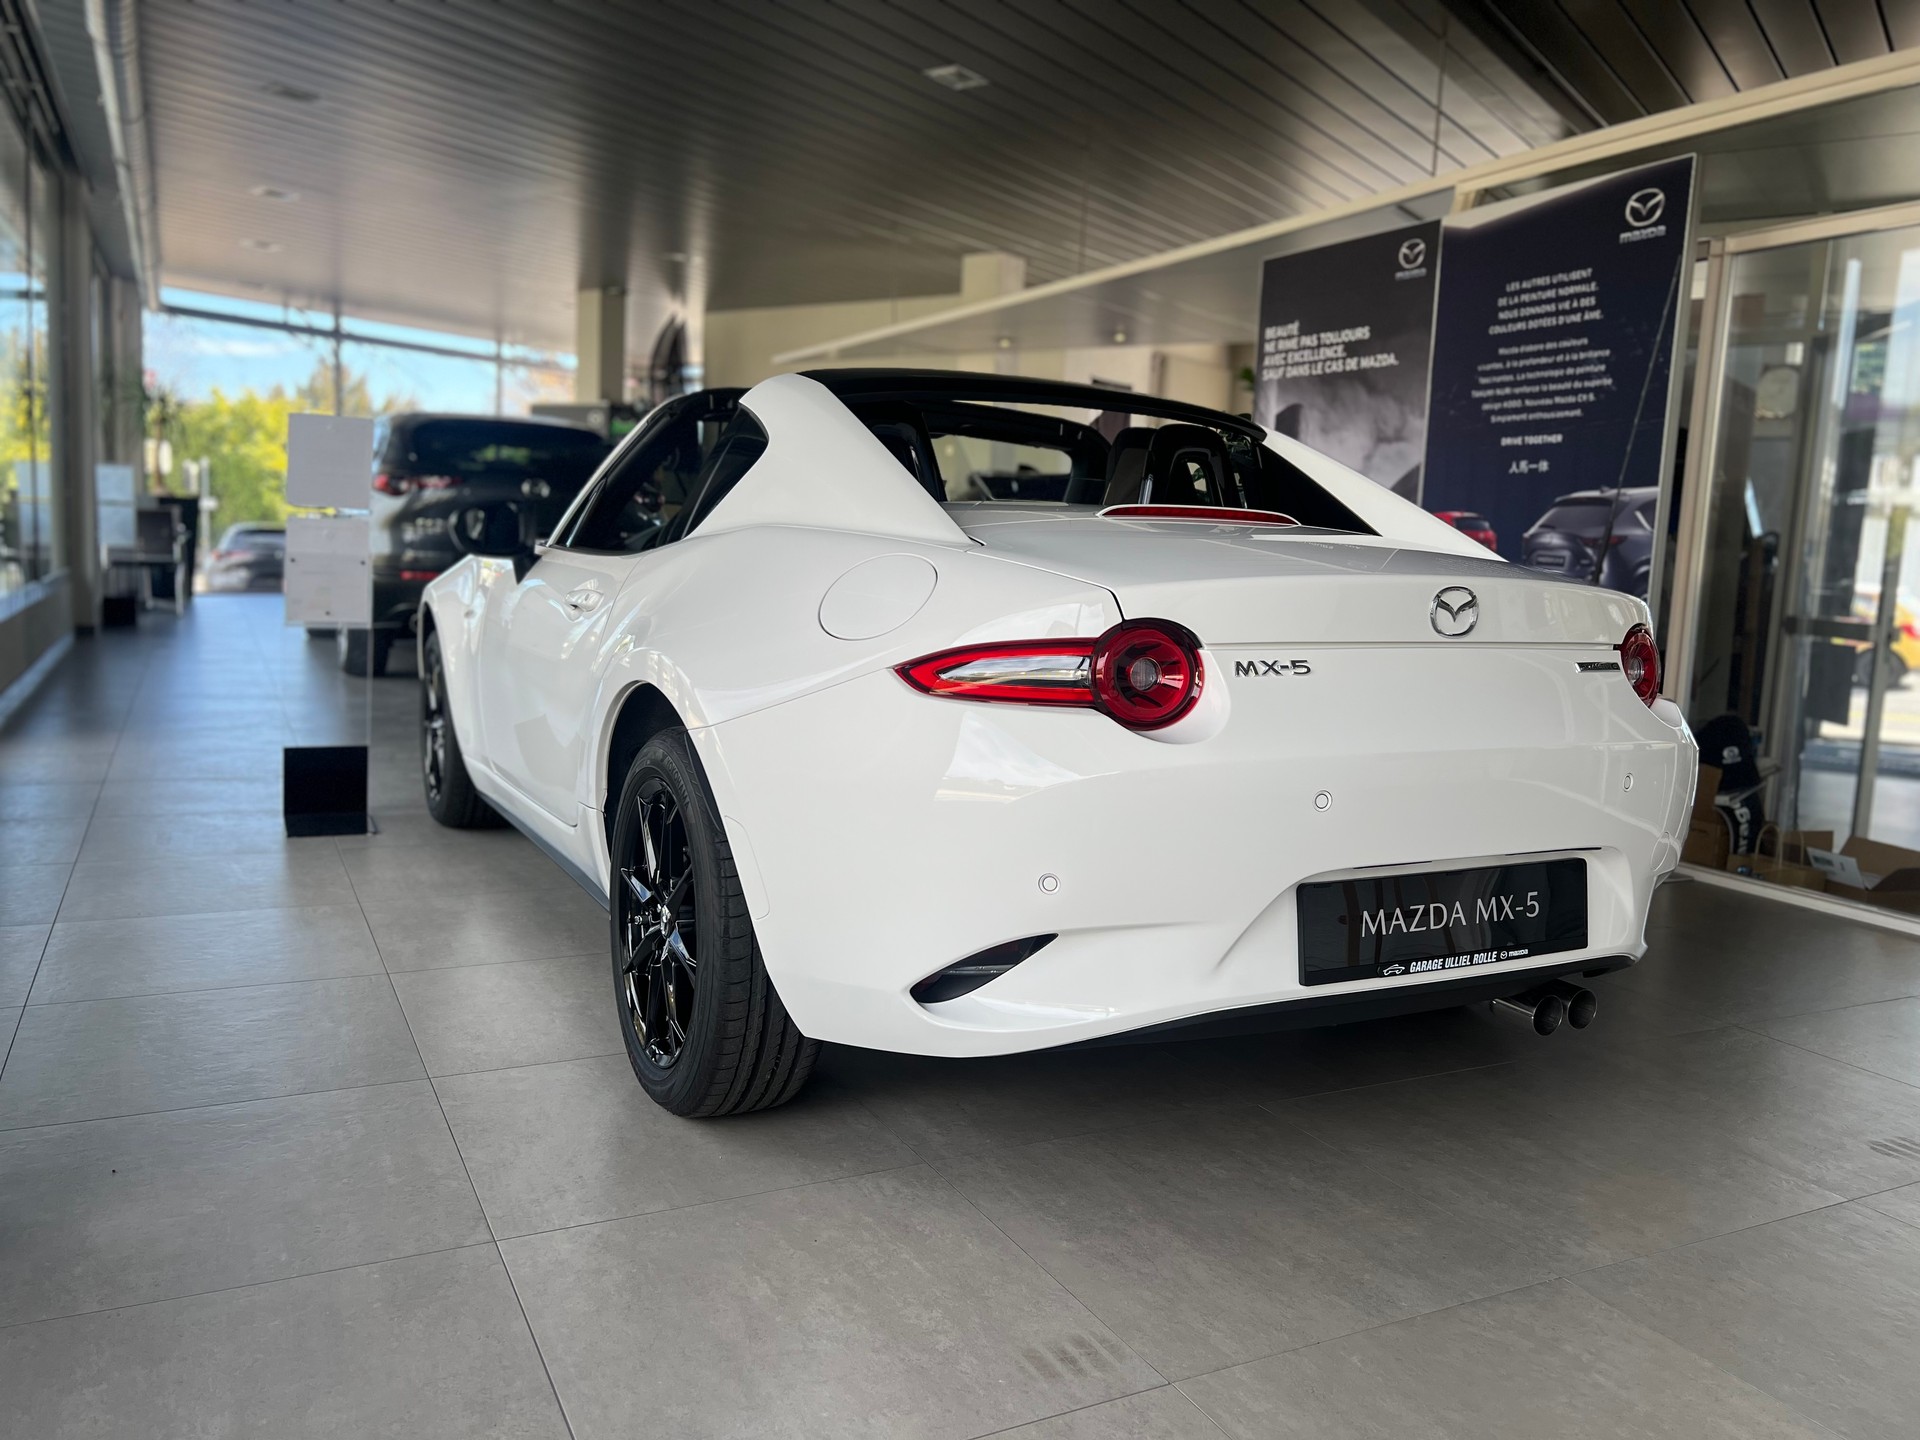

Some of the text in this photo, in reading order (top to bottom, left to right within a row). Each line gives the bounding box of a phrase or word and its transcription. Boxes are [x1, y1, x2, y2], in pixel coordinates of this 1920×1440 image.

[1501, 433, 1563, 446] DRIVE TOGETHER
[1234, 660, 1311, 677] MX-5
[1362, 891, 1540, 938] MAZDA MX-5
[1410, 949, 1528, 973] GARAGE ULLIEL ROLLE mazda
